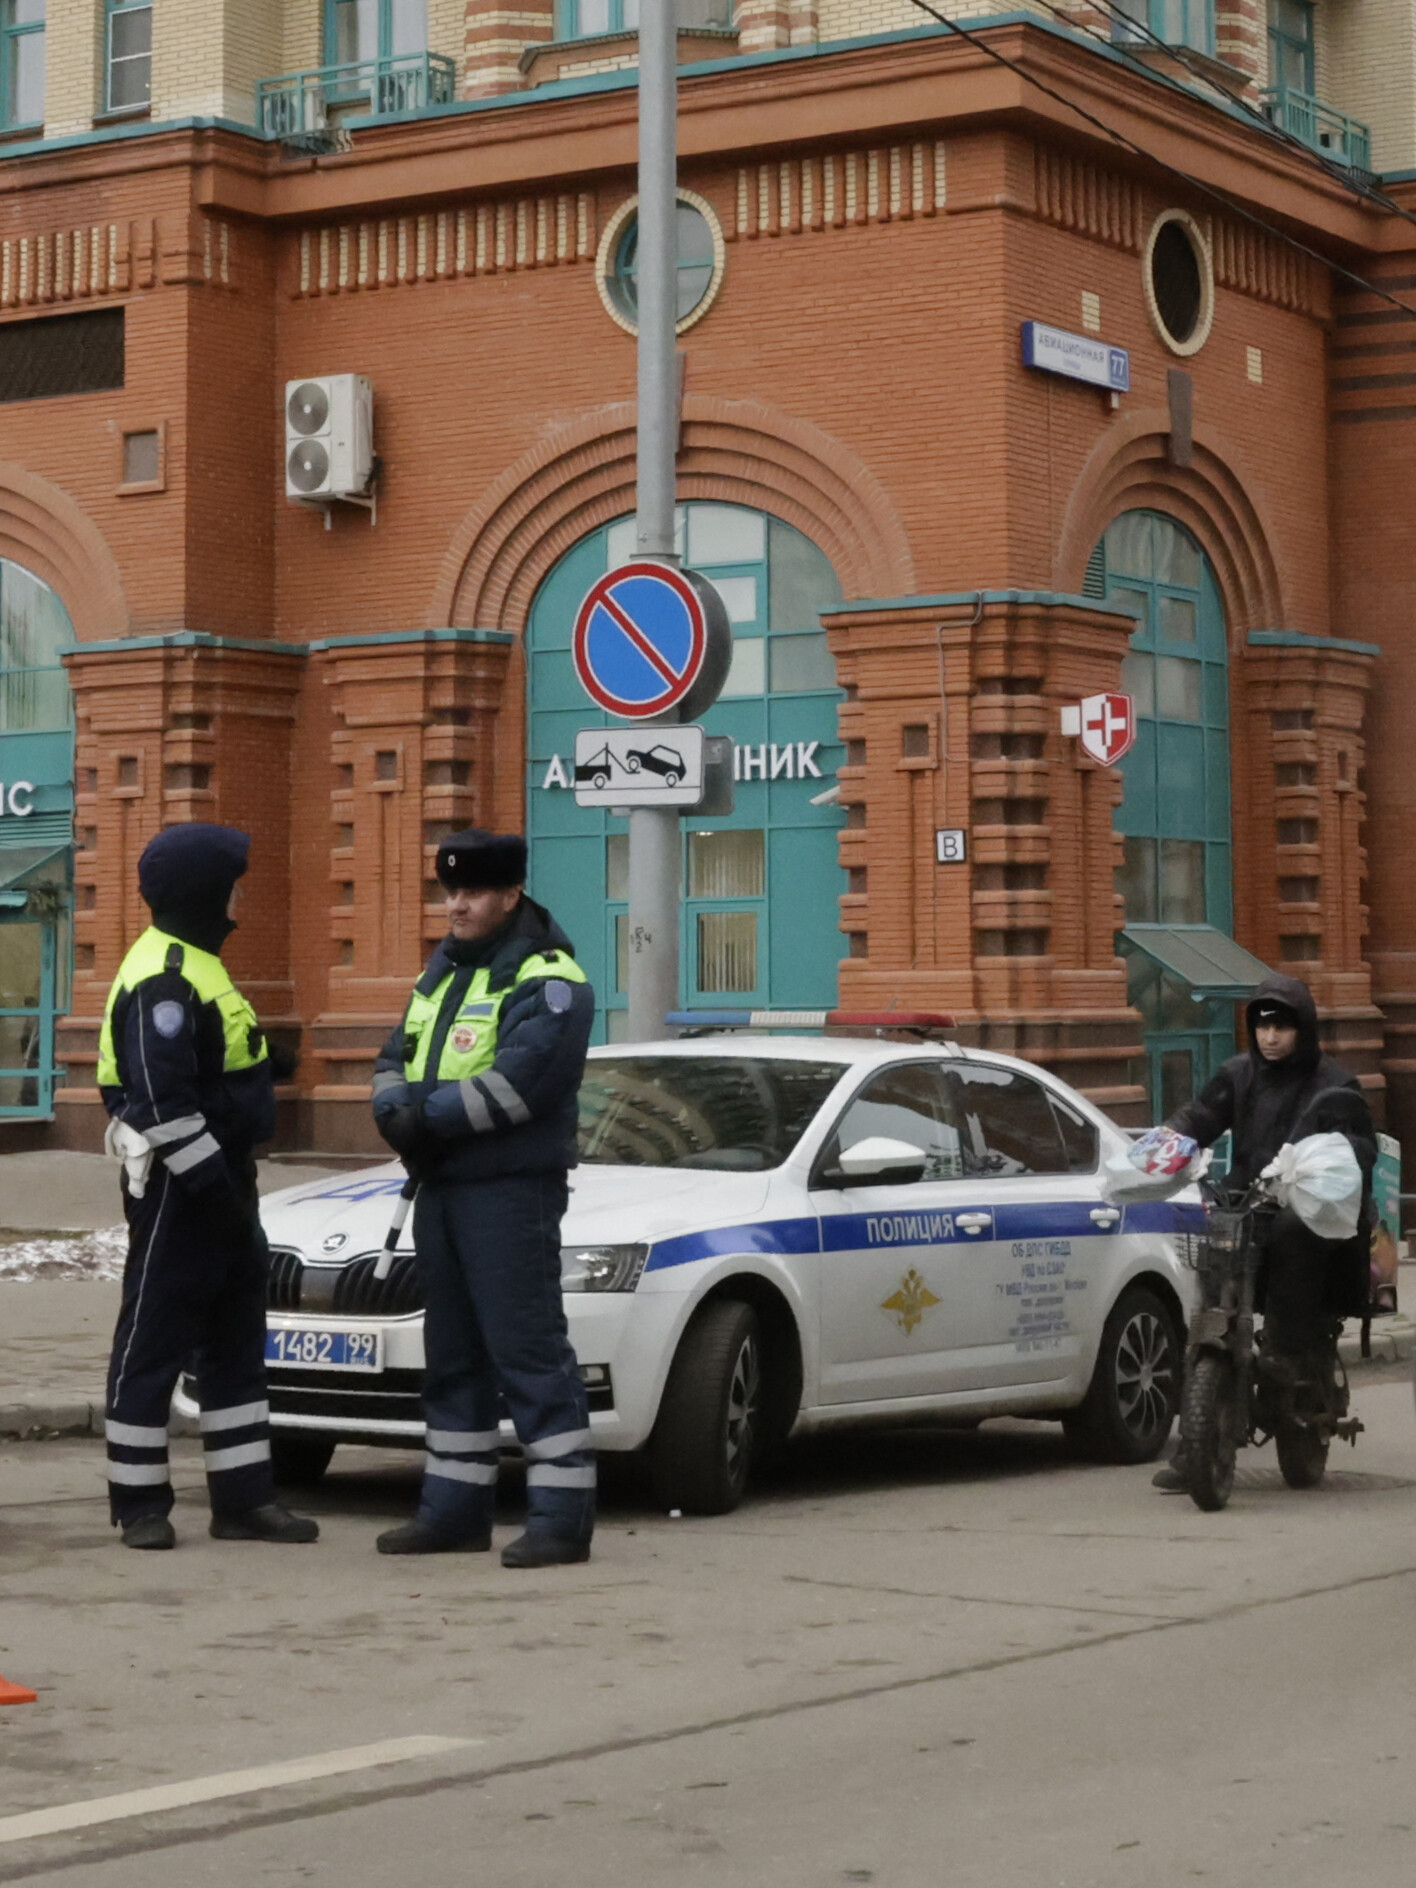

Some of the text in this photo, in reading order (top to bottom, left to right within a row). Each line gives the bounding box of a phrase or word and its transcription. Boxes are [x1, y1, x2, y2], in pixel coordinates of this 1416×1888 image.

[1111, 354, 1125, 377] 77
[866, 1213, 955, 1243] ПОЛИЦИЯ
[273, 1331, 373, 1362] 1482 99
